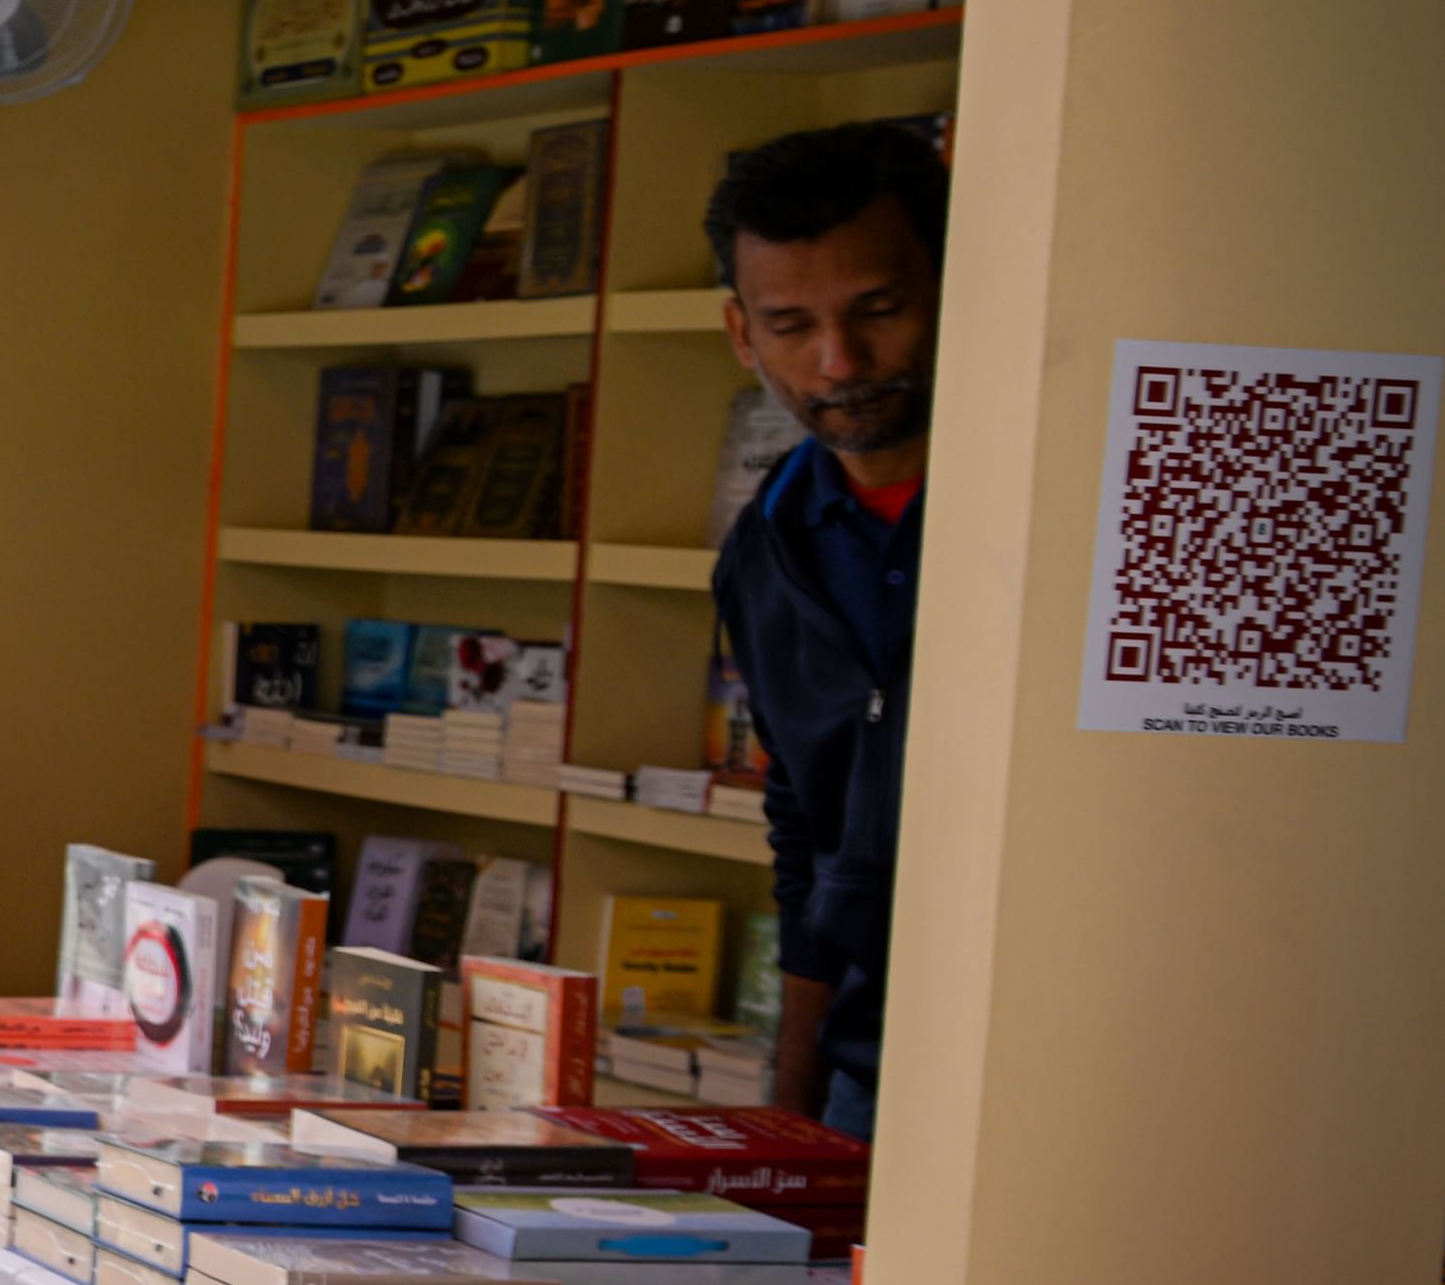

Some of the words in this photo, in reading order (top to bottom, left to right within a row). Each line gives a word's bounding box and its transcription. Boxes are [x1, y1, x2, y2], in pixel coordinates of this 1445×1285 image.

[1142, 717, 1185, 732] SCAN
[1187, 719, 1207, 733] TO
[1211, 720, 1249, 735] VIEW
[1252, 722, 1283, 736] OUR
[1287, 724, 1340, 739] BOOKS
